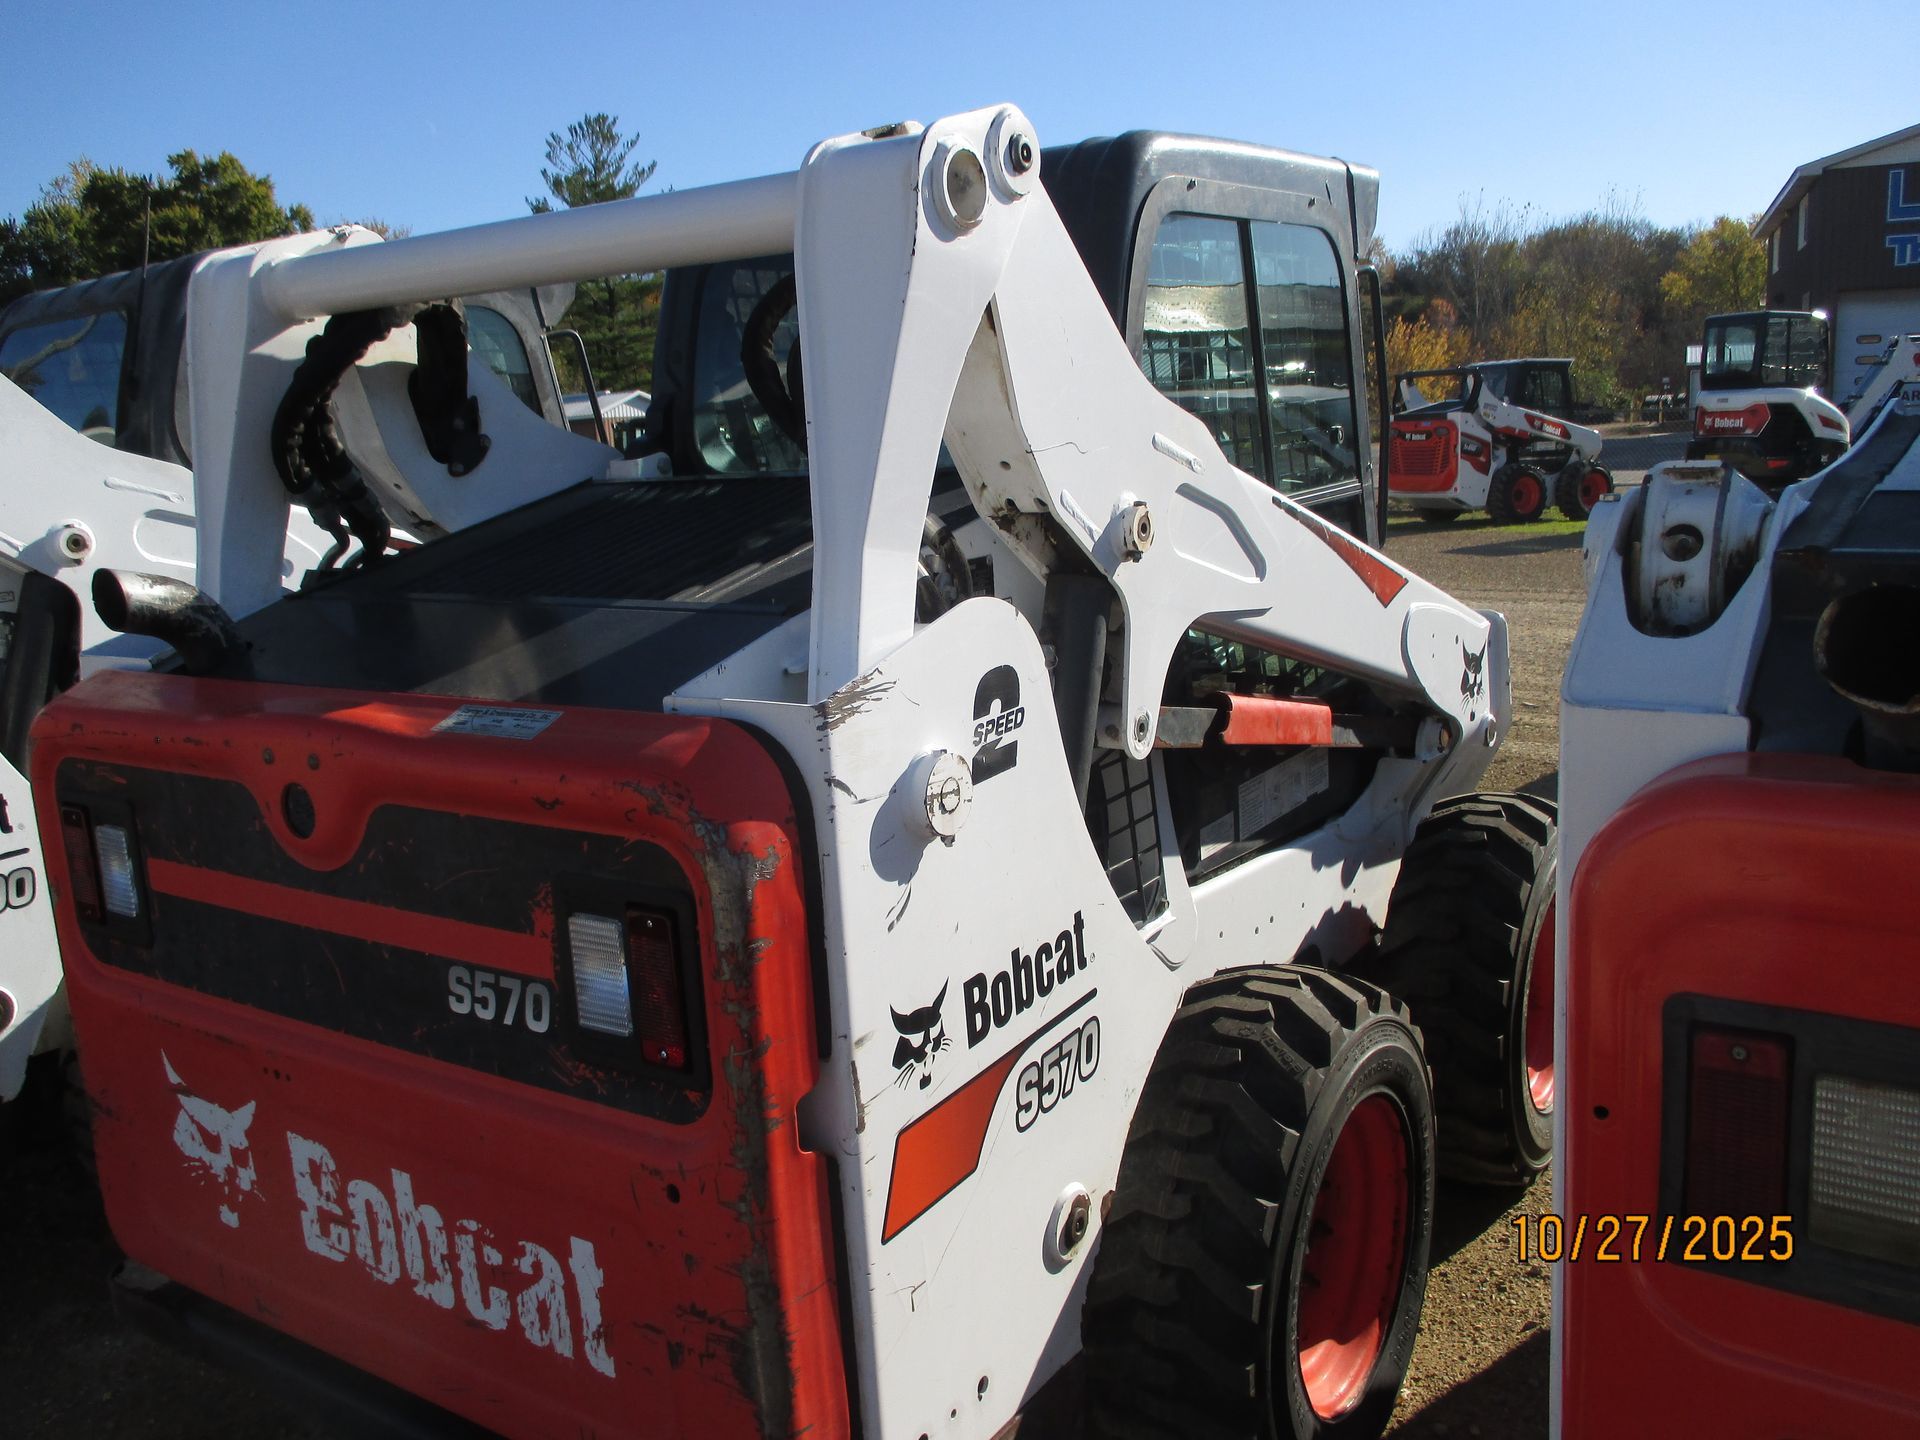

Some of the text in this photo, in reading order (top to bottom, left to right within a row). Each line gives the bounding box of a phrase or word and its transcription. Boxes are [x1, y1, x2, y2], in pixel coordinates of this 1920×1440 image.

[1411, 433, 1426, 441] Bobcat
[1542, 422, 1562, 436] Bobcat
[1714, 417, 1744, 428] Bobcat
[973, 706, 1025, 747] SPEED
[447, 965, 551, 1034] S570
[963, 909, 1088, 1050] Bobcat
[1016, 1015, 1101, 1134] S570
[287, 1131, 616, 1378] Bobcat
